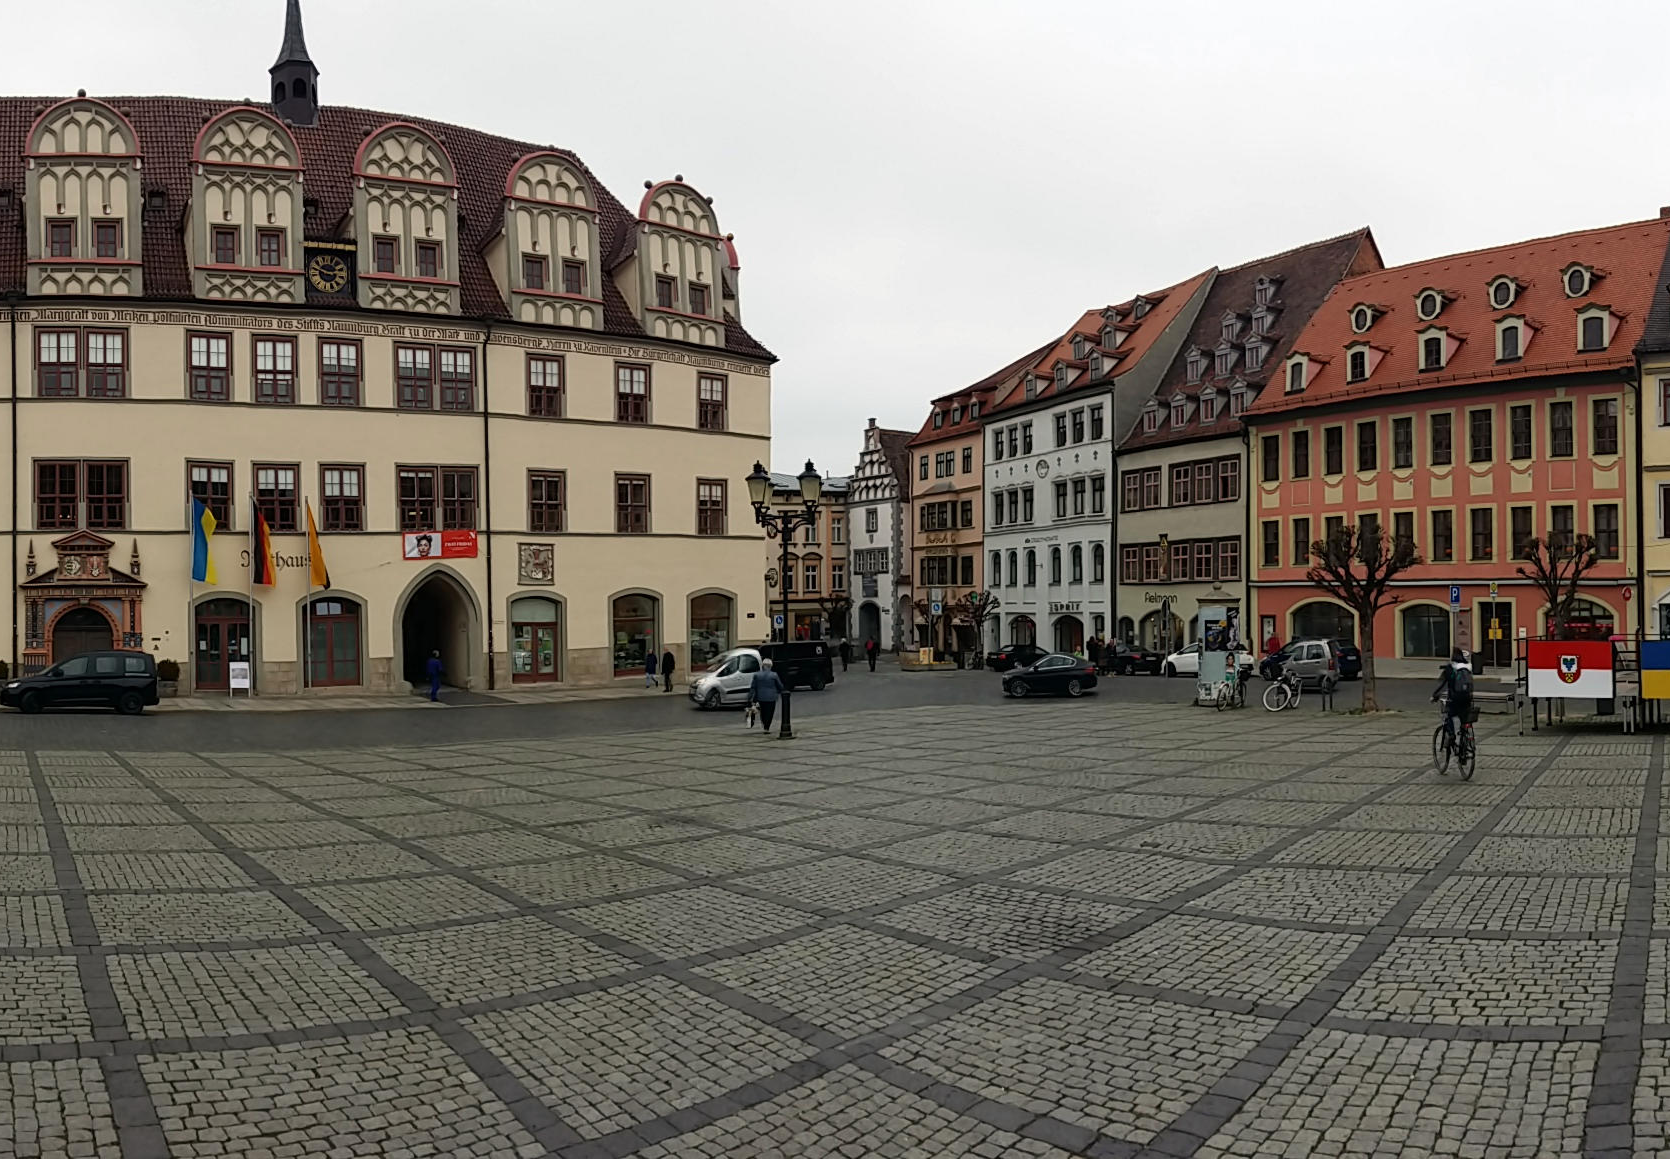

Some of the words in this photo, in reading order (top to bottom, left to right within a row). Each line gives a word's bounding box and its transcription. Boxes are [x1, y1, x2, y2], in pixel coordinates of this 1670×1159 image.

[91, 311, 109, 320] von
[277, 317, 293, 329] des
[464, 331, 479, 341] und
[240, 550, 312, 571] Rhaus
